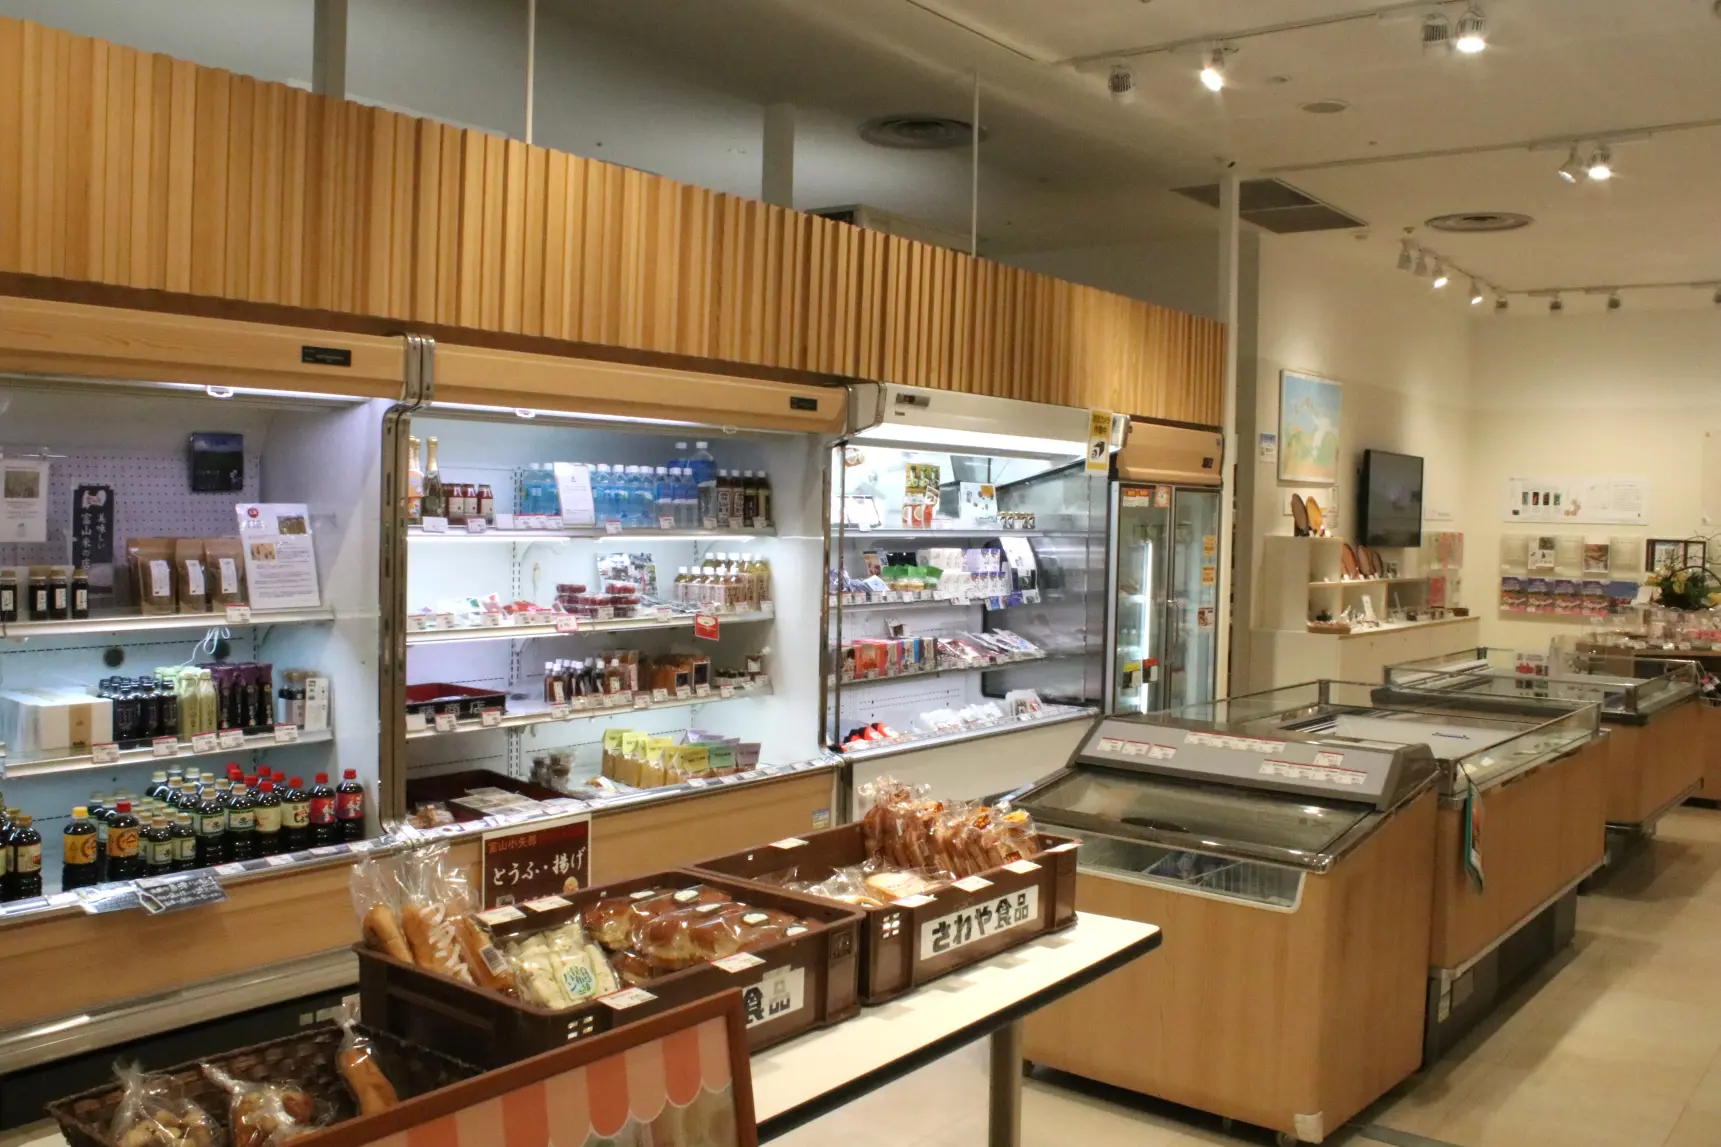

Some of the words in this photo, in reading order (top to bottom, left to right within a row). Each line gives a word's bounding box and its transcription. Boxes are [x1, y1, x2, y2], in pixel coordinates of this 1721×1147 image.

[80, 512, 93, 570] 富山米の店
[488, 834, 537, 854] 富山小矢部
[492, 846, 587, 886] とうふ・揚げ
[931, 893, 1030, 953] さわや食品
